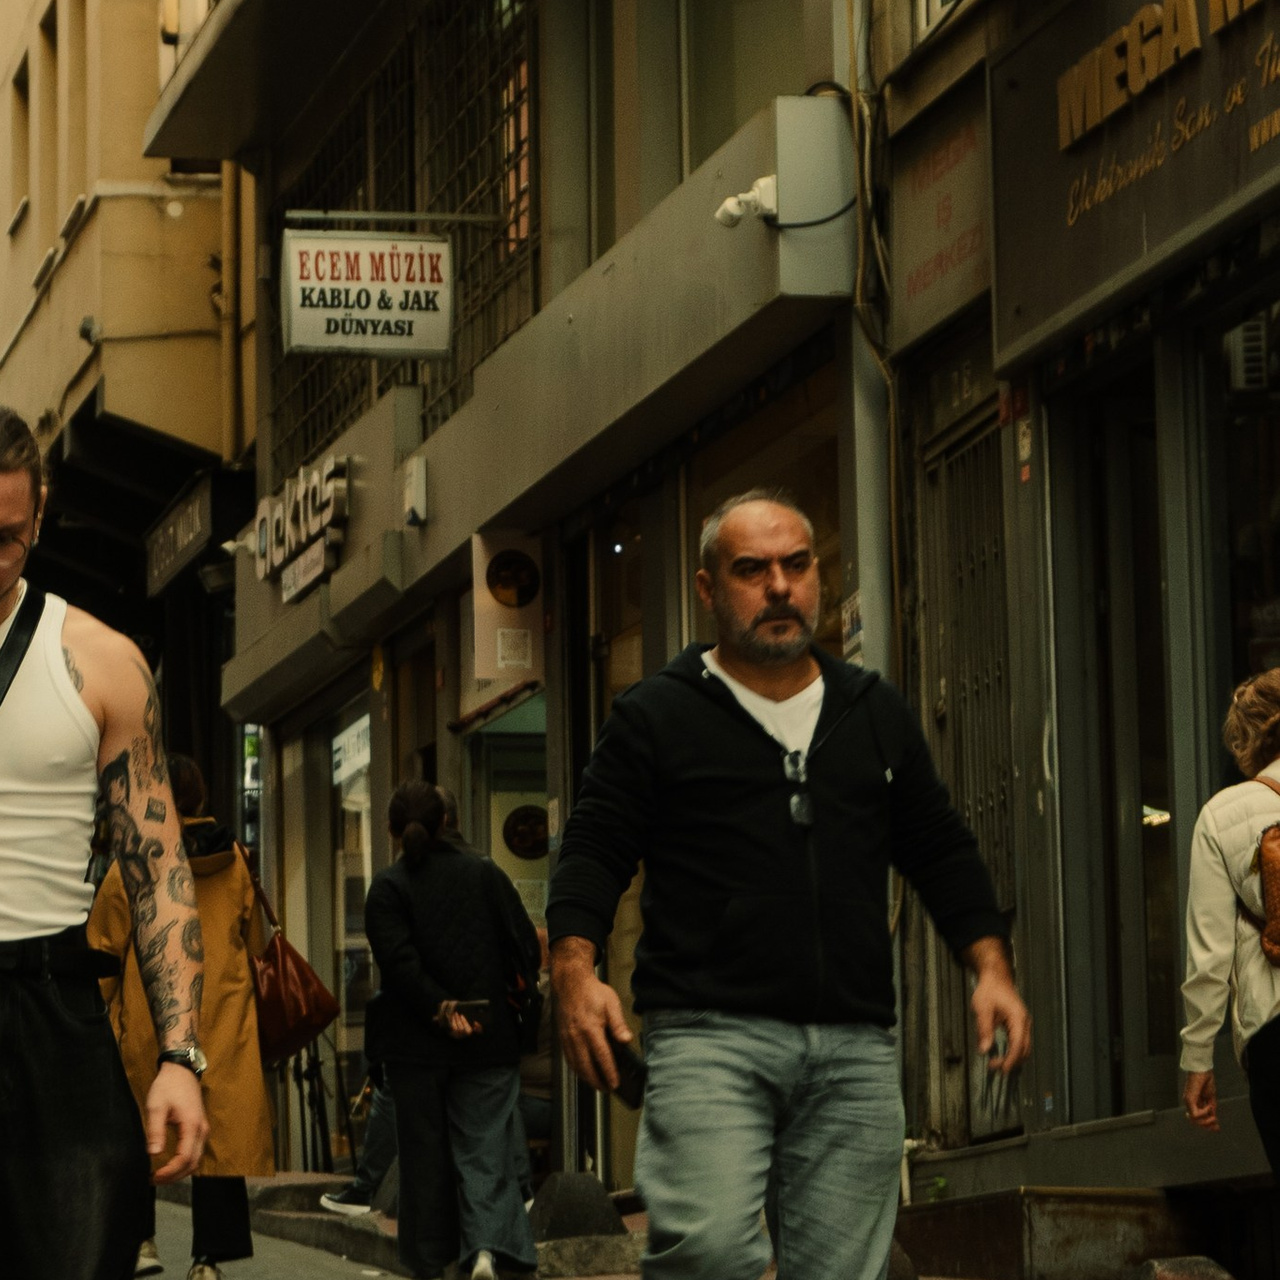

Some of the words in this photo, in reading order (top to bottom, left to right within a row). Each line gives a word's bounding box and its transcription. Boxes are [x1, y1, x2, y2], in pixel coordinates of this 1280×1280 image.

[299, 250, 362, 281] ECEM
[370, 244, 443, 283] MÜZİK
[300, 287, 371, 310] KABLO
[377, 289, 393, 310] &
[399, 290, 439, 312] JAK
[325, 313, 414, 336] DÜNYASI
